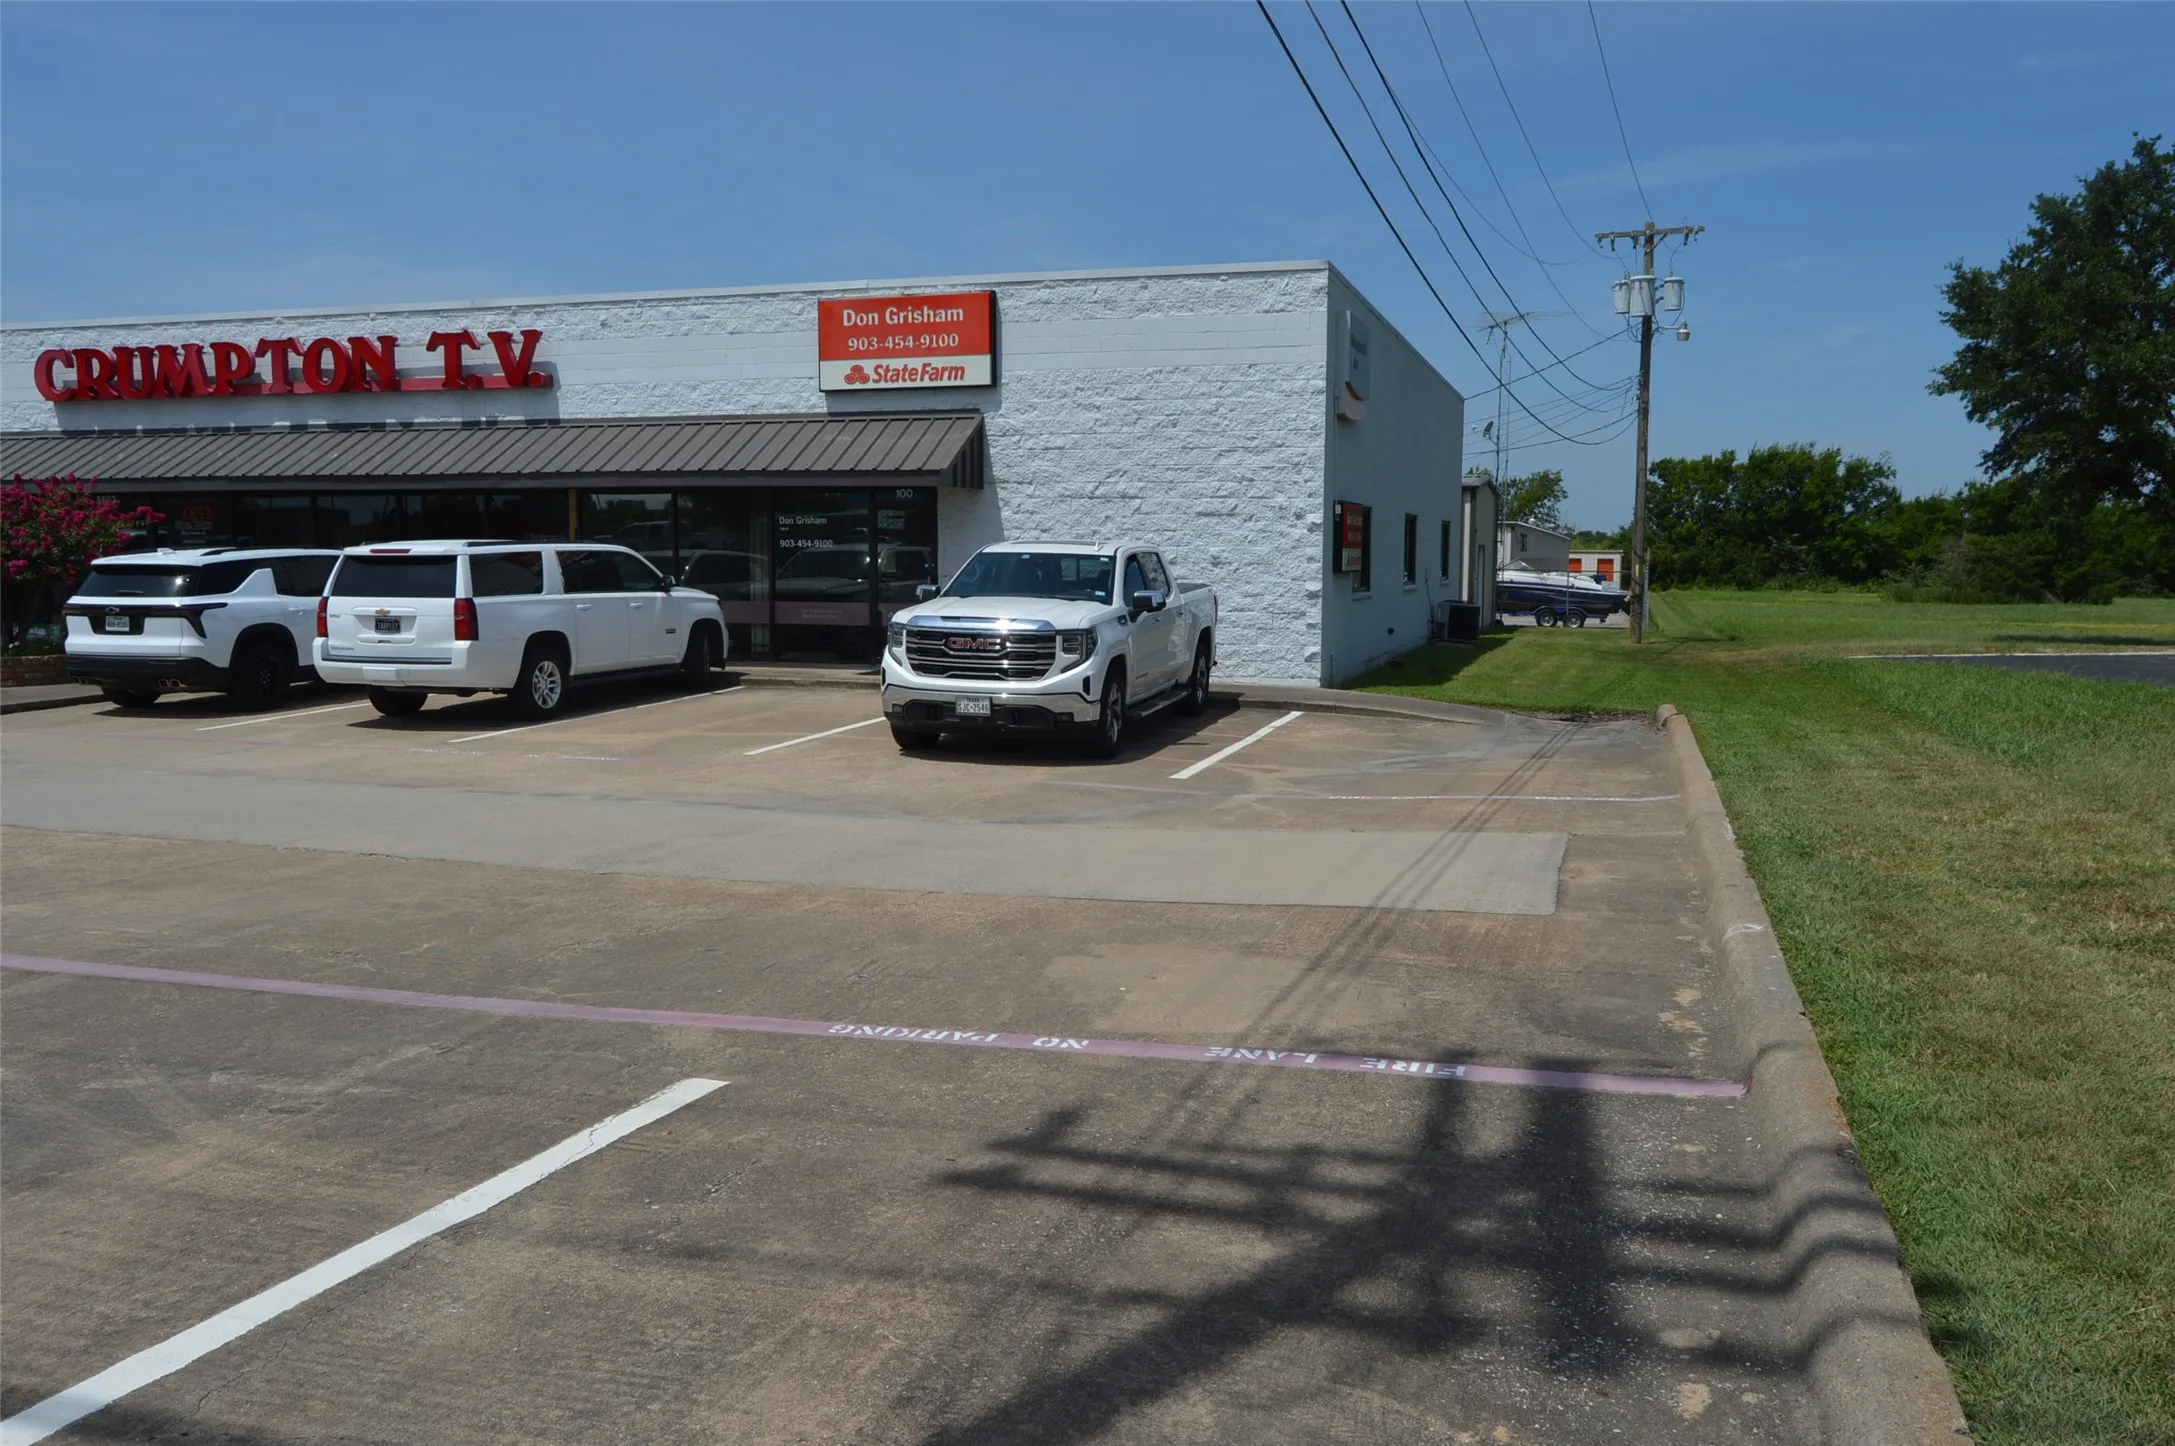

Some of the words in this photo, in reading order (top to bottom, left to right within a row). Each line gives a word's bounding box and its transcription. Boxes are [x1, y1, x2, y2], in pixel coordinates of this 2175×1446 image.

[842, 308, 879, 327] Don
[884, 304, 964, 325] Grisham
[848, 332, 960, 351] 903-454-9100
[34, 334, 400, 402] CRUMPTON
[426, 329, 552, 390] T.V.
[895, 488, 914, 498] 100
[779, 515, 794, 525] Don
[795, 515, 828, 525] Grisham
[779, 539, 833, 548] 903-454-9100
[947, 637, 1001, 650] GMC
[828, 1024, 1000, 1042] PARKING
[1032, 1037, 1090, 1049] NO
[1204, 1046, 1318, 1064] LANE
[1359, 1057, 1466, 1078] FIRE
